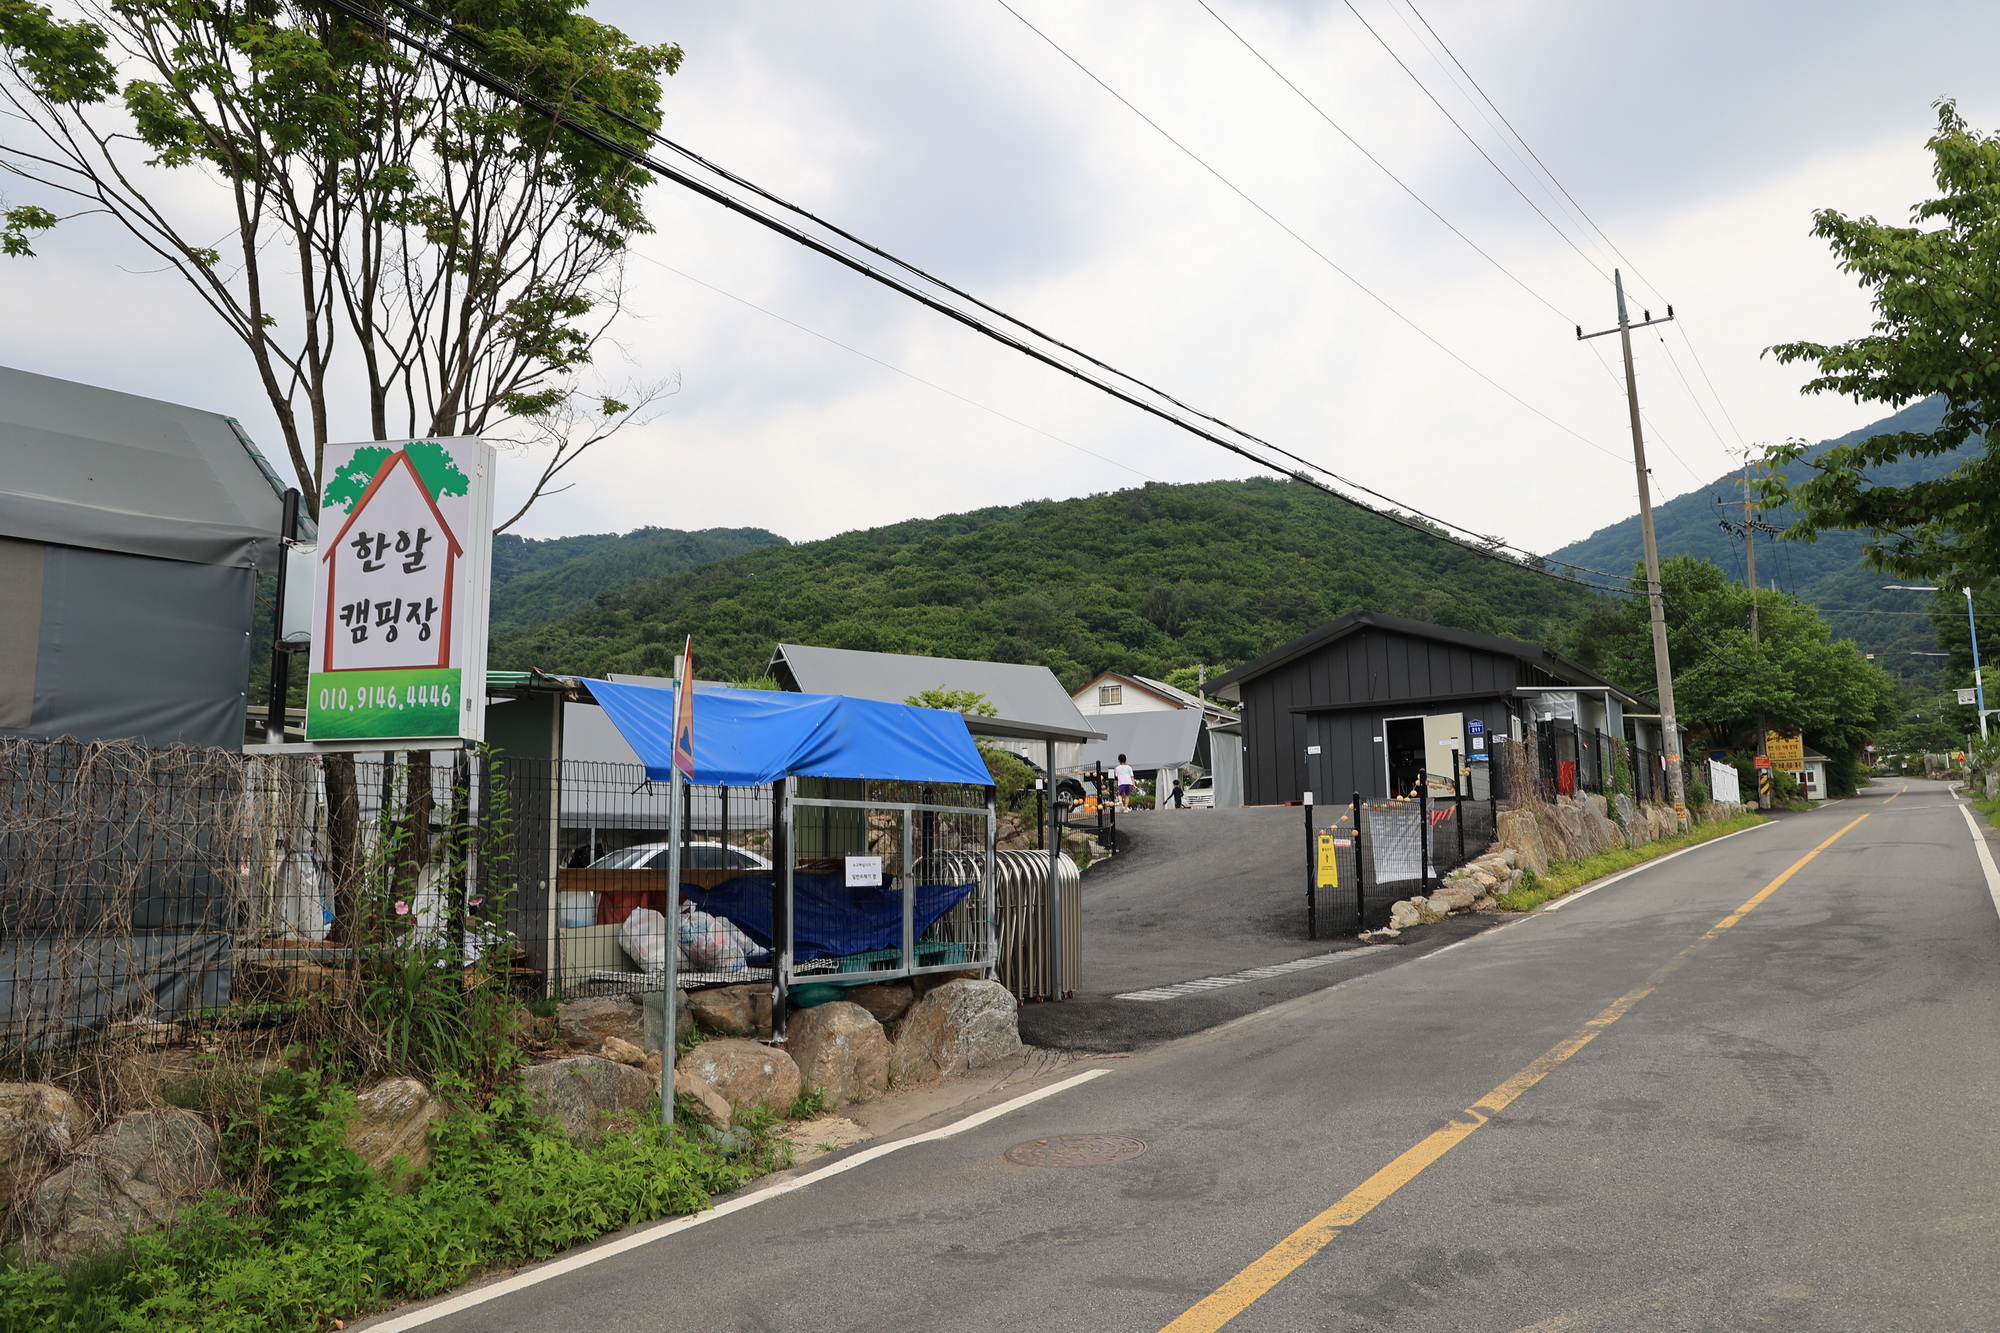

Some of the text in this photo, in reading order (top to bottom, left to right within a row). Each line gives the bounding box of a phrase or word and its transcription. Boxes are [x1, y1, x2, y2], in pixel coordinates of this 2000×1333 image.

[351, 527, 433, 574] 한알
[339, 597, 438, 644] 캠핑장
[319, 684, 451, 712] 010.9146.4446
